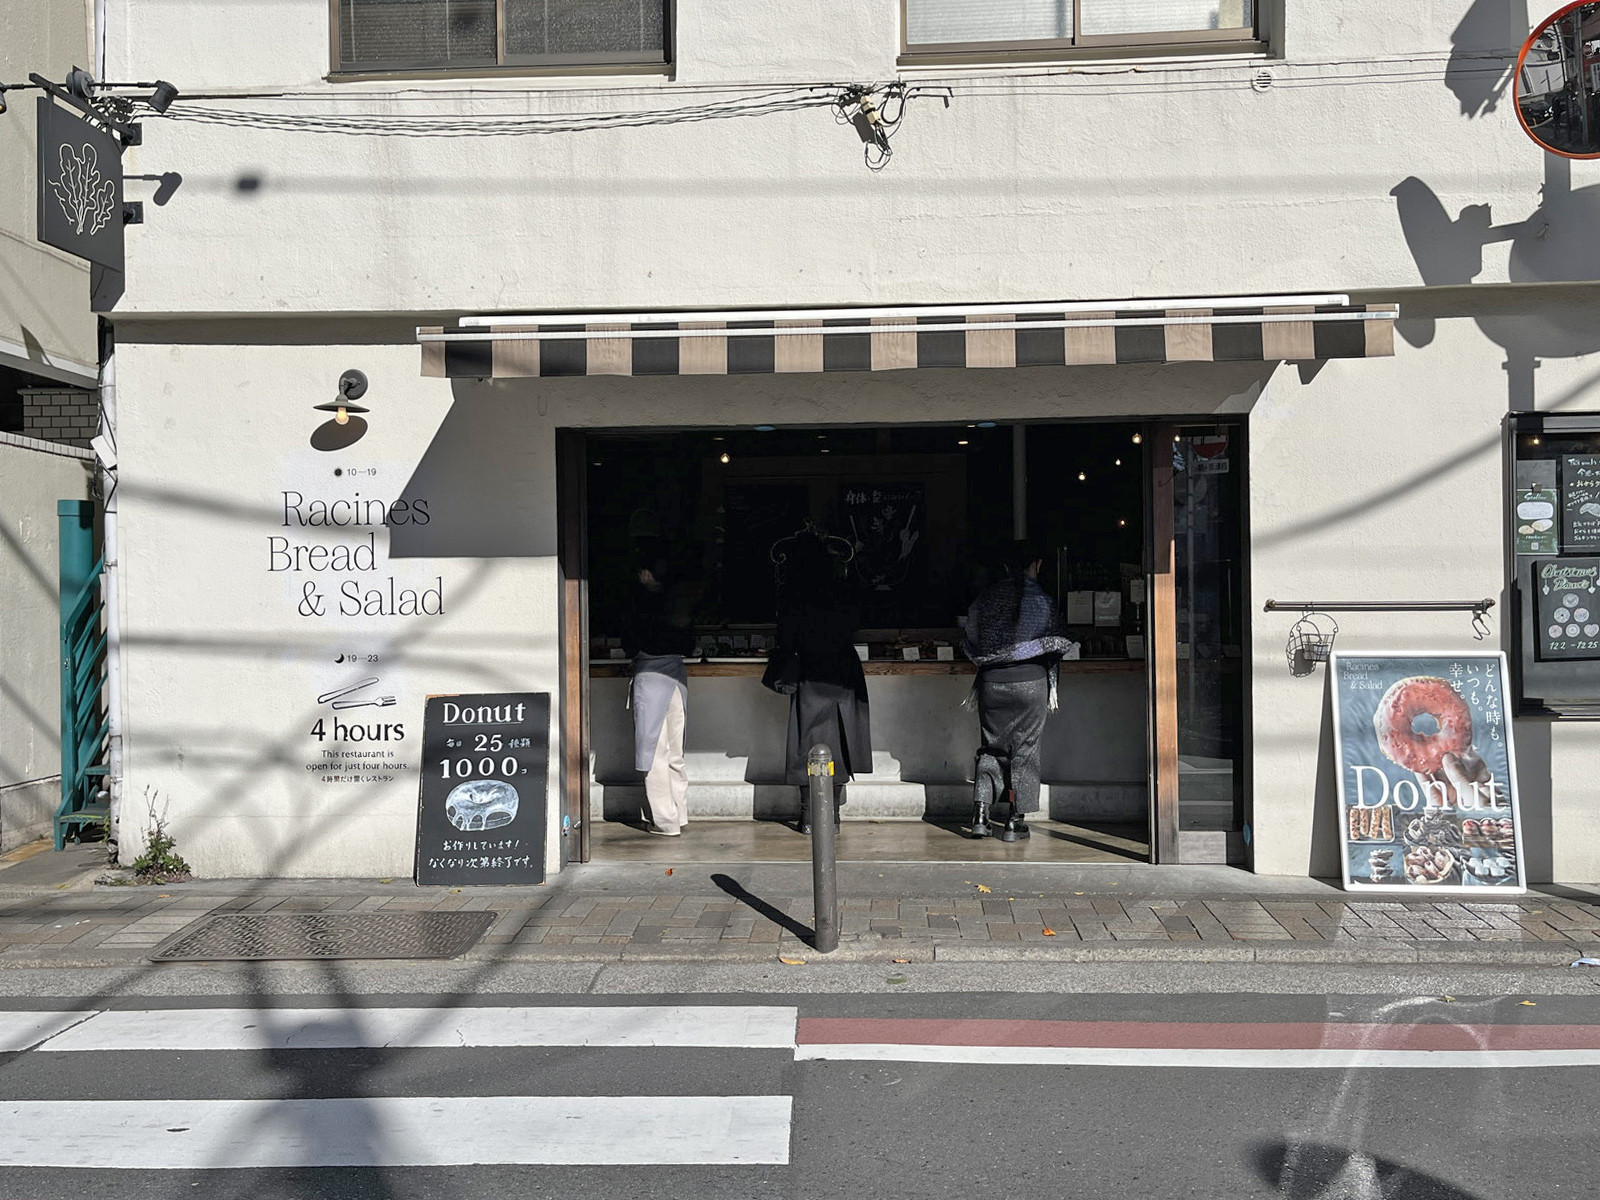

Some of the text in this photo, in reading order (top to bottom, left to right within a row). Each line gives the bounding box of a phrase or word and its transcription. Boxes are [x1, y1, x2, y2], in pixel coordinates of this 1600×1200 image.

[281, 490, 431, 527] Racines
[266, 532, 378, 572] Bread
[297, 576, 446, 617] & Salad
[1343, 671, 1369, 680] Bread
[1346, 661, 1380, 671] Racines
[1350, 681, 1384, 690] & Salad
[1449, 663, 1466, 700] 幸せ。
[1466, 665, 1483, 711] いつも。
[442, 702, 527, 724] Donut
[1485, 664, 1503, 748] どんな時も。
[309, 716, 405, 742] 4 hours
[321, 749, 395, 758] This restaurant is
[474, 733, 503, 752] 25
[305, 761, 410, 773] open for just four hours.
[1350, 765, 1508, 813] Donut
